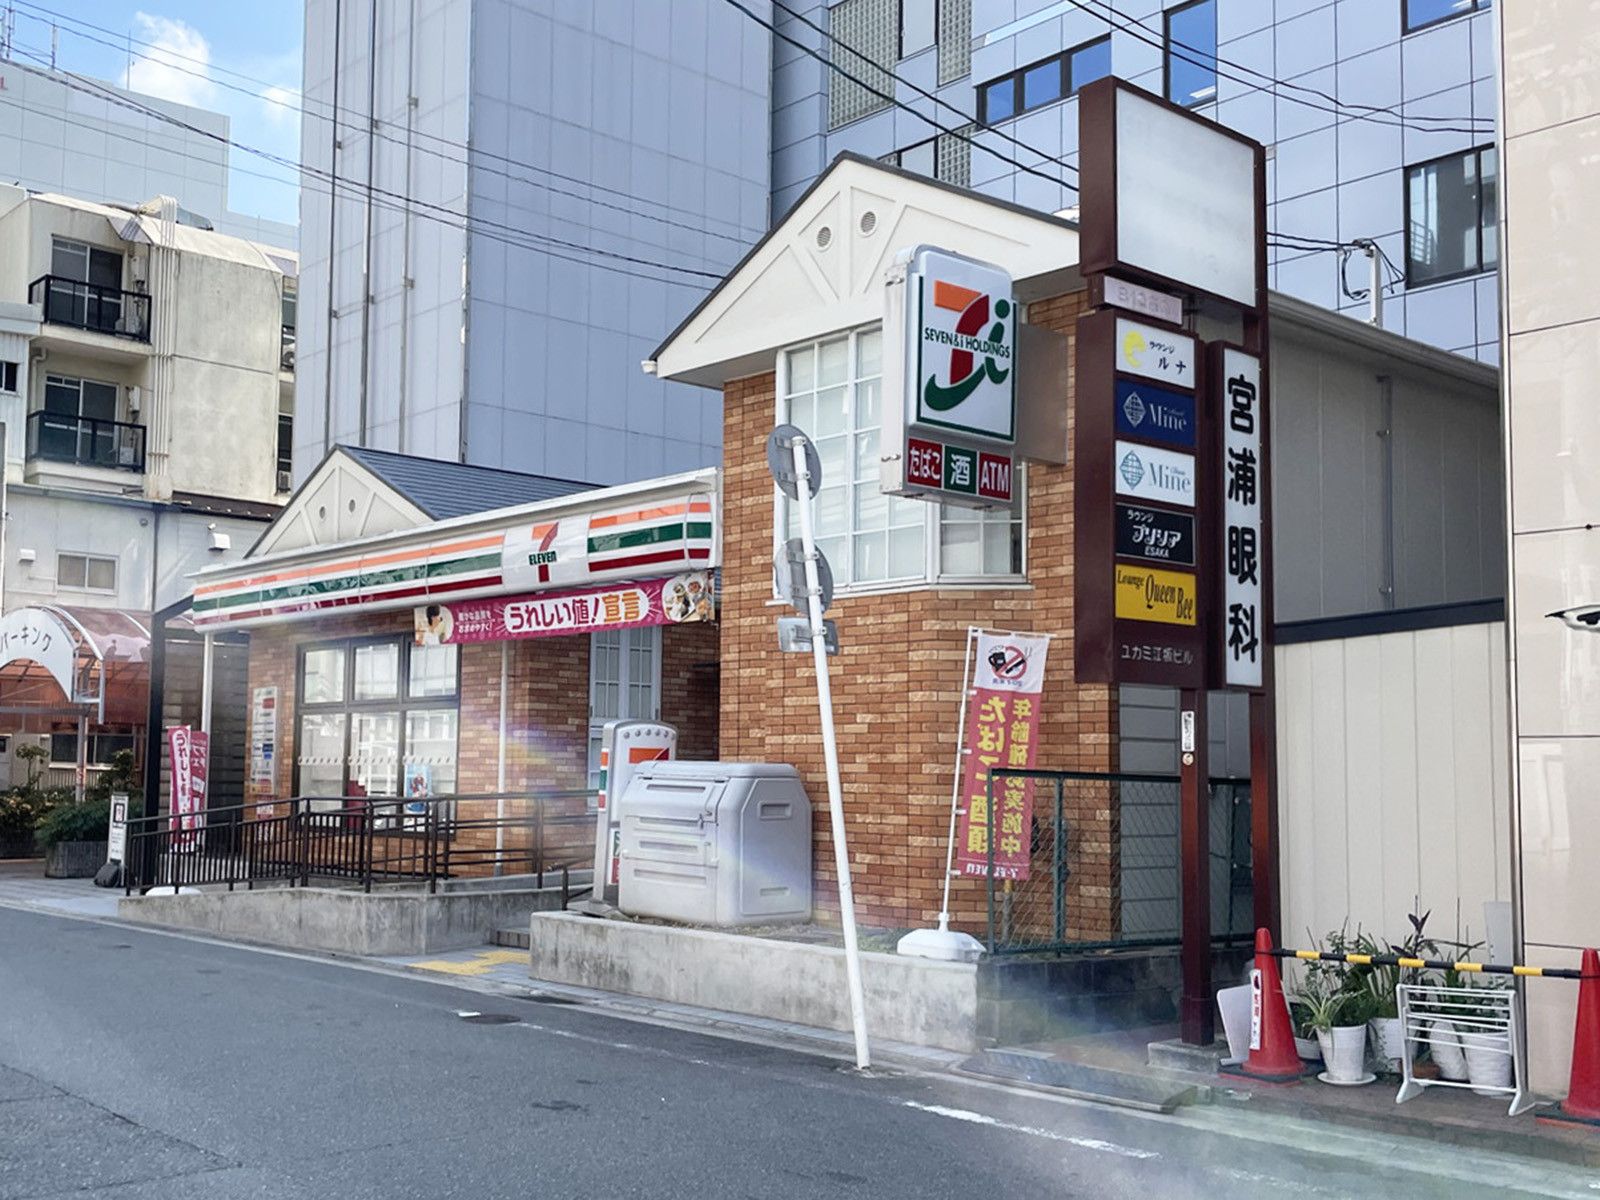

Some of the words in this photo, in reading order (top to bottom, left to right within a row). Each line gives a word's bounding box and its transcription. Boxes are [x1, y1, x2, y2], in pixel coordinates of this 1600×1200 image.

[965, 336, 1010, 358] HOLDINGS
[1158, 356, 1187, 375] ルナ
[1149, 403, 1188, 432] Mine
[909, 447, 941, 480] たばこ
[950, 453, 972, 486] 酒
[980, 460, 1010, 494] ATM
[1149, 462, 1192, 494] Mine
[1227, 373, 1259, 664] 宮浦眼科
[1144, 545, 1170, 558] ESAKA
[1117, 569, 1145, 590] Lounge
[1145, 574, 1176, 610] Queen
[1176, 587, 1193, 620] Bee
